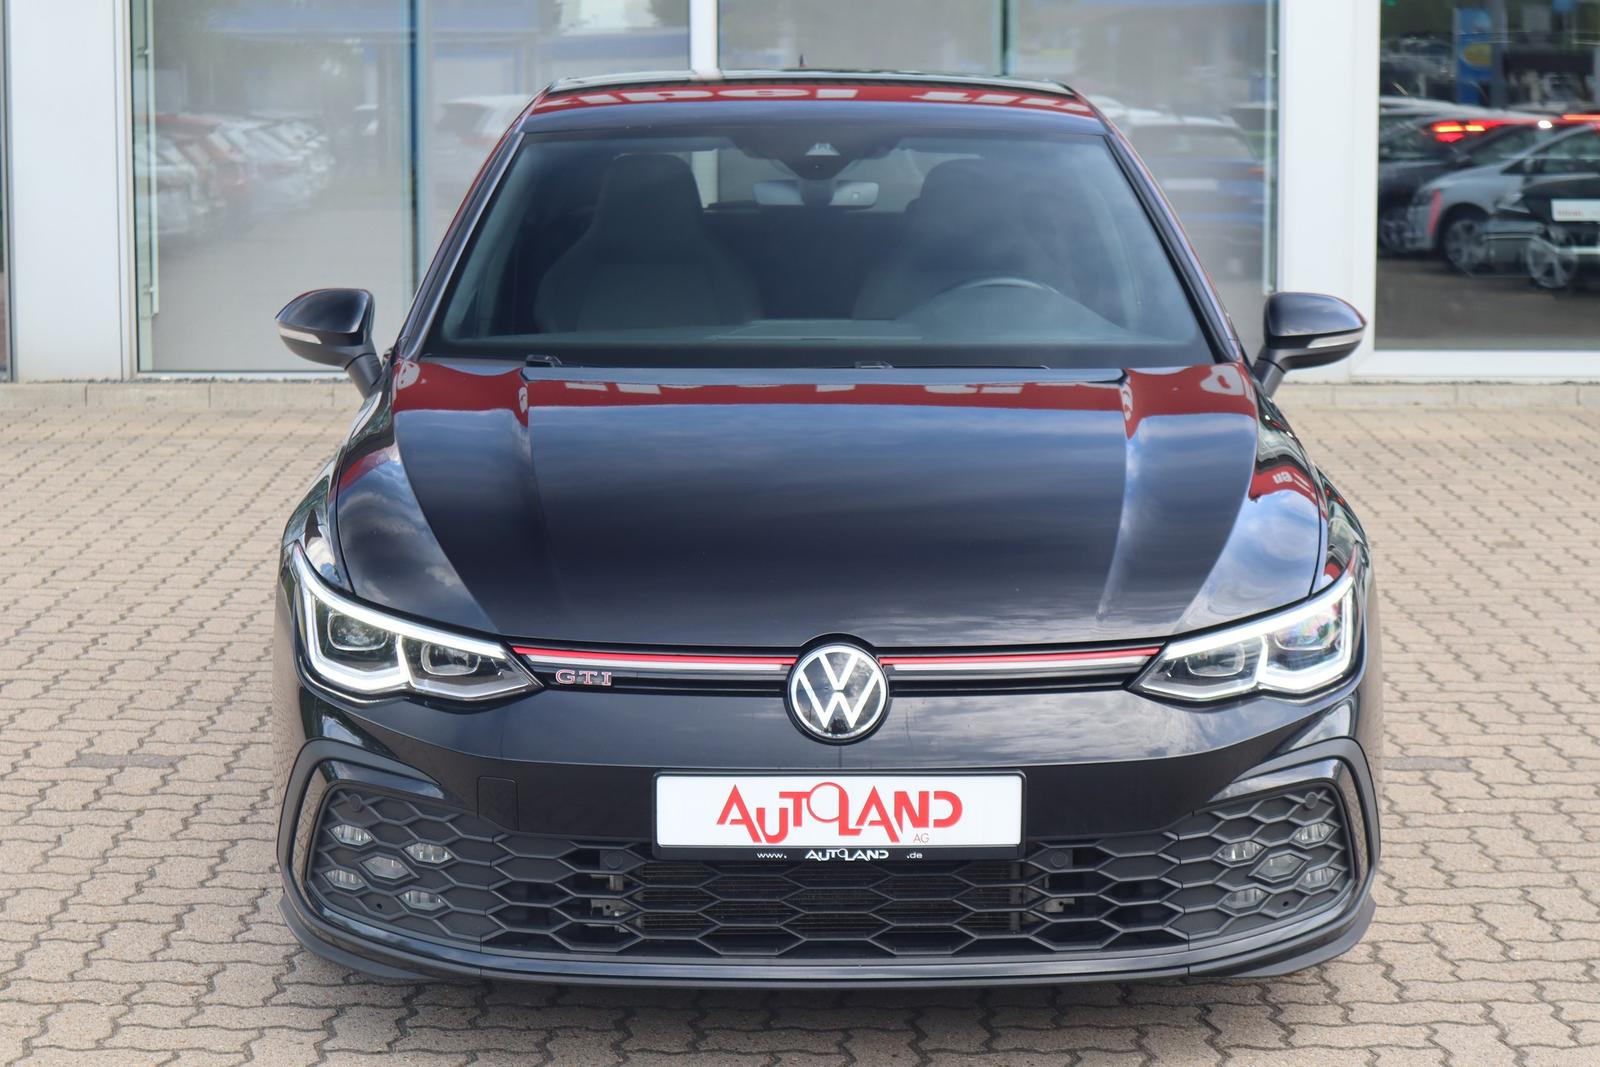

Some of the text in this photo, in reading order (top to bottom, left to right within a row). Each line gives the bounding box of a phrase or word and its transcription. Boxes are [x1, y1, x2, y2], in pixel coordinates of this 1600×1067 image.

[555, 669, 612, 687] GTI
[716, 781, 963, 844] AUTOLAND
[913, 832, 930, 843] AG
[756, 848, 923, 861] www. AUTOLAND .de
